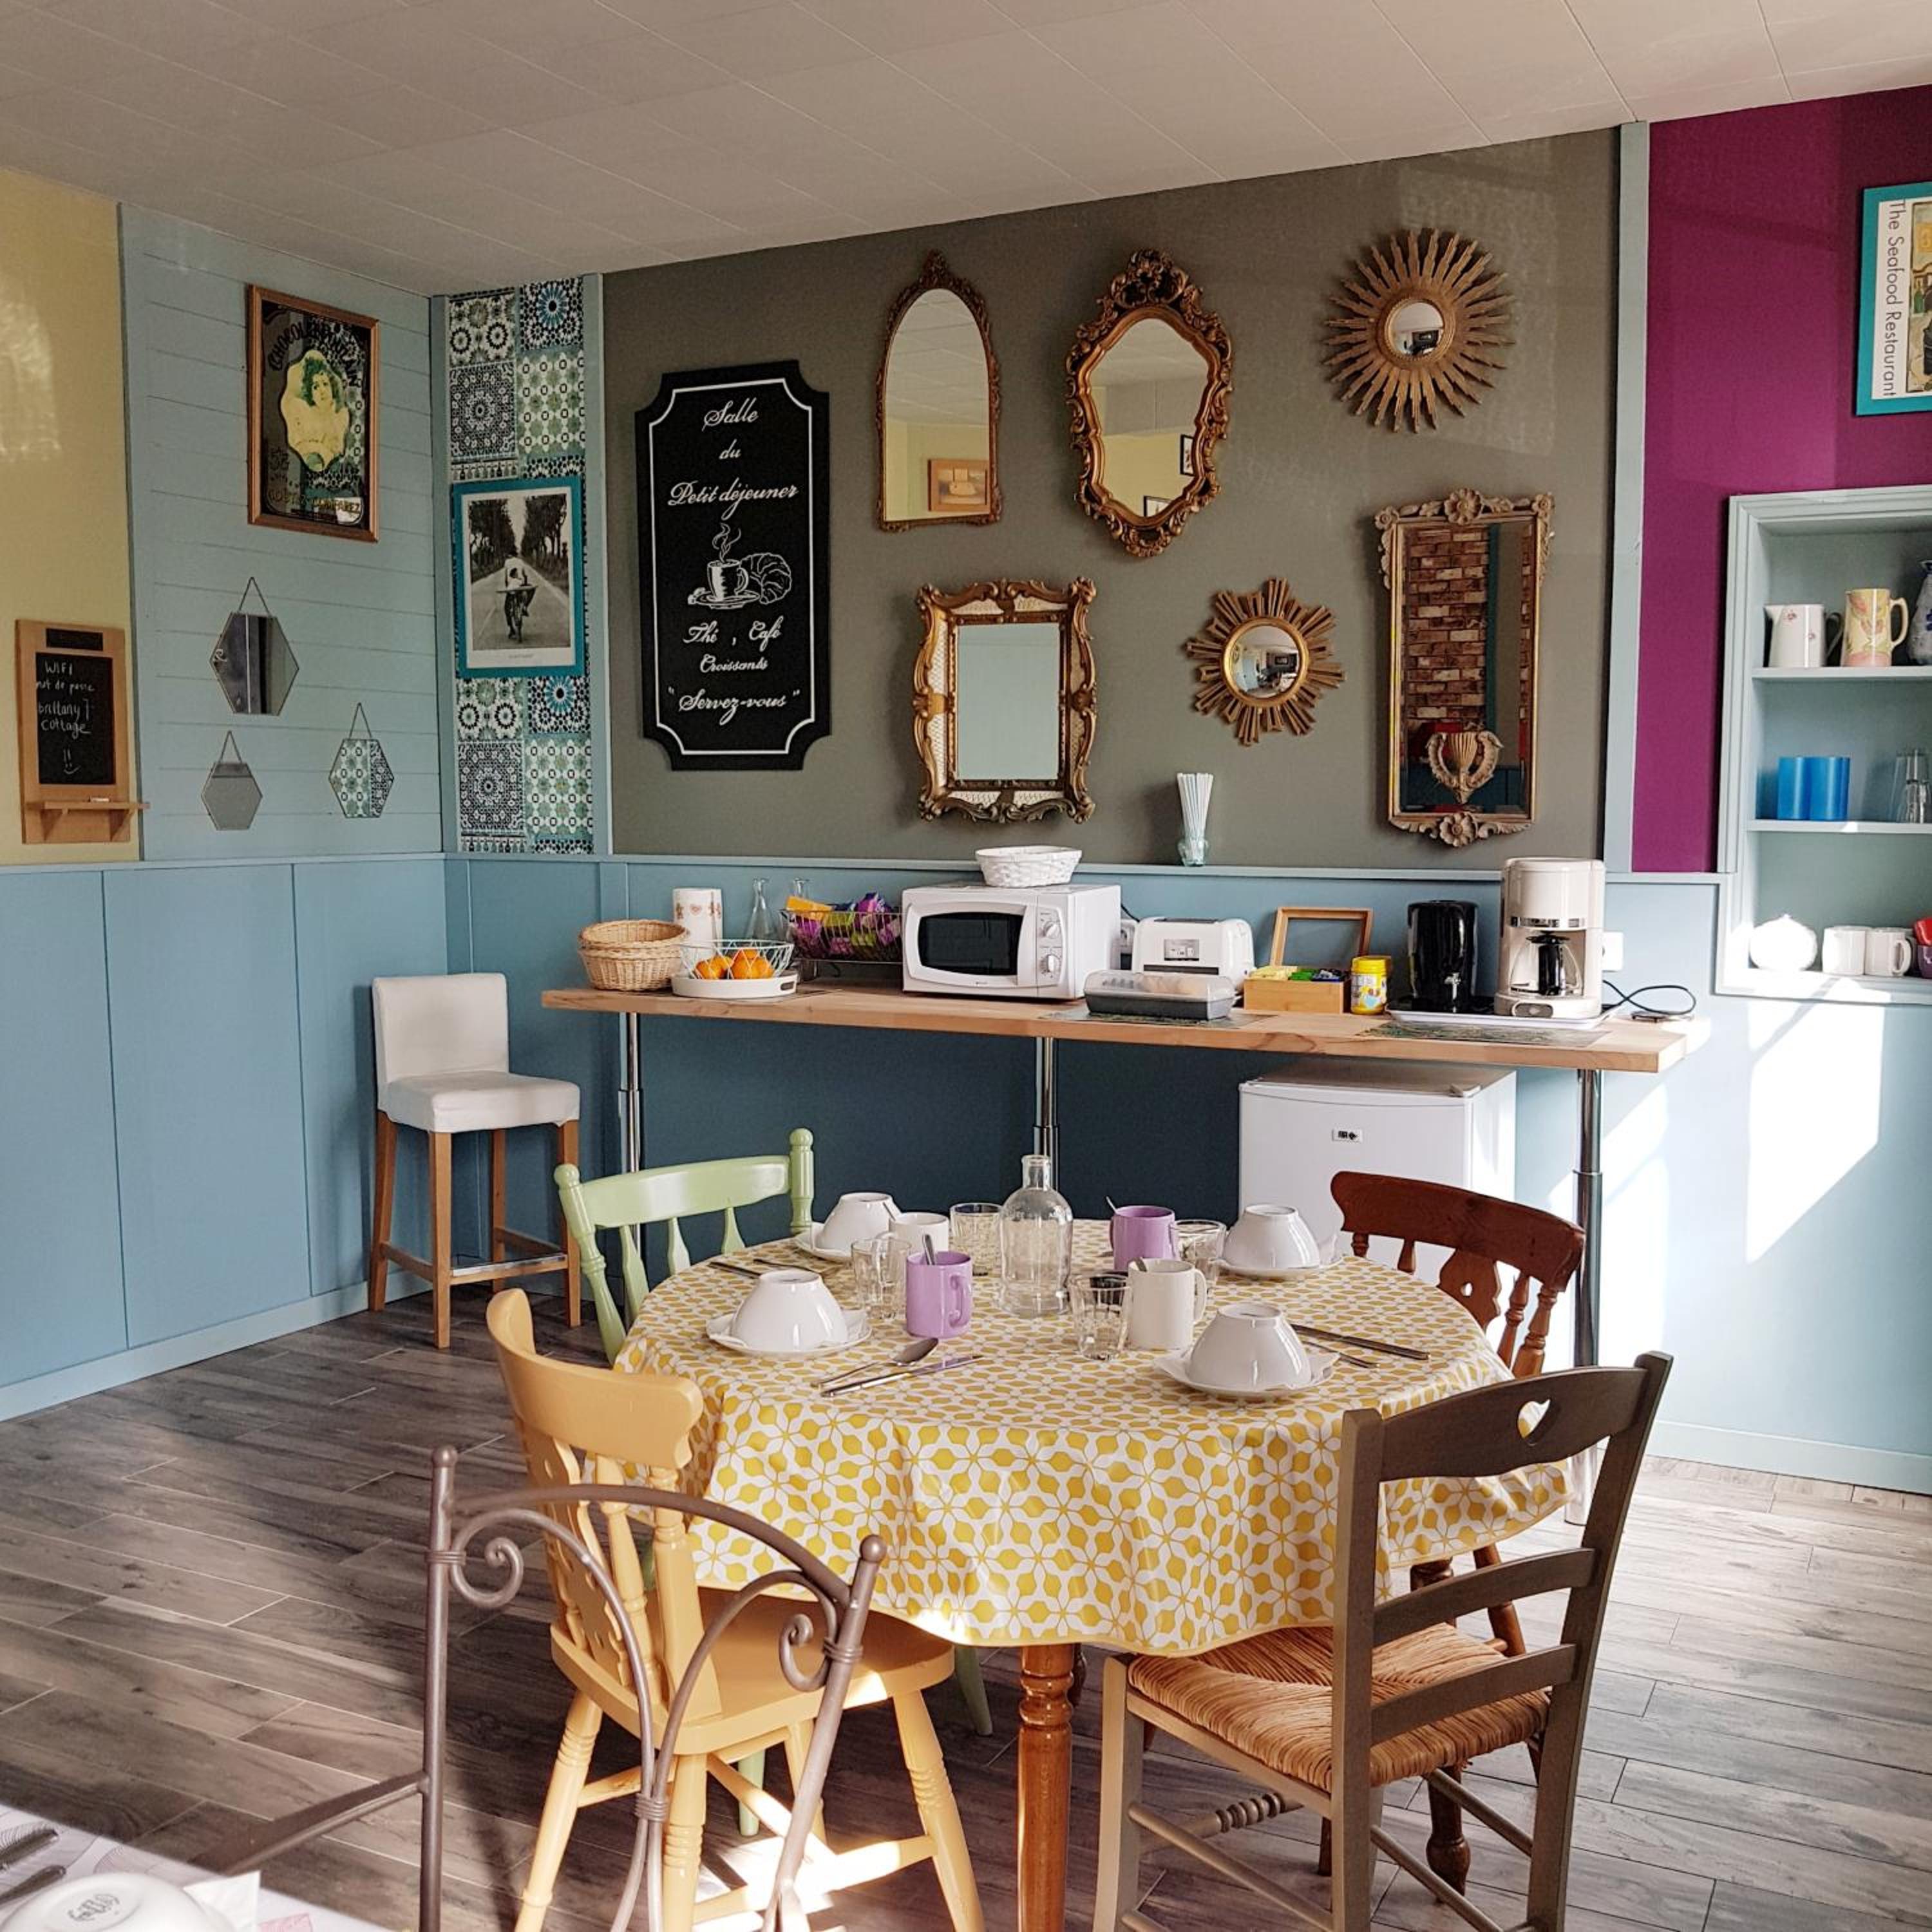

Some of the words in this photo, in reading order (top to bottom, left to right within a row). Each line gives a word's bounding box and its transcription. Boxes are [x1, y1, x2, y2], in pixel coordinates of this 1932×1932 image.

[1889, 199, 1907, 230] The
[1886, 236, 1905, 305] Seafood
[1882, 311, 1902, 397] Restaurant
[701, 397, 759, 432] Salle
[719, 439, 741, 460] du
[667, 480, 719, 506] Petit
[718, 477, 799, 521] déjeuner
[749, 615, 784, 652] Café
[699, 654, 768, 674] Croissants
